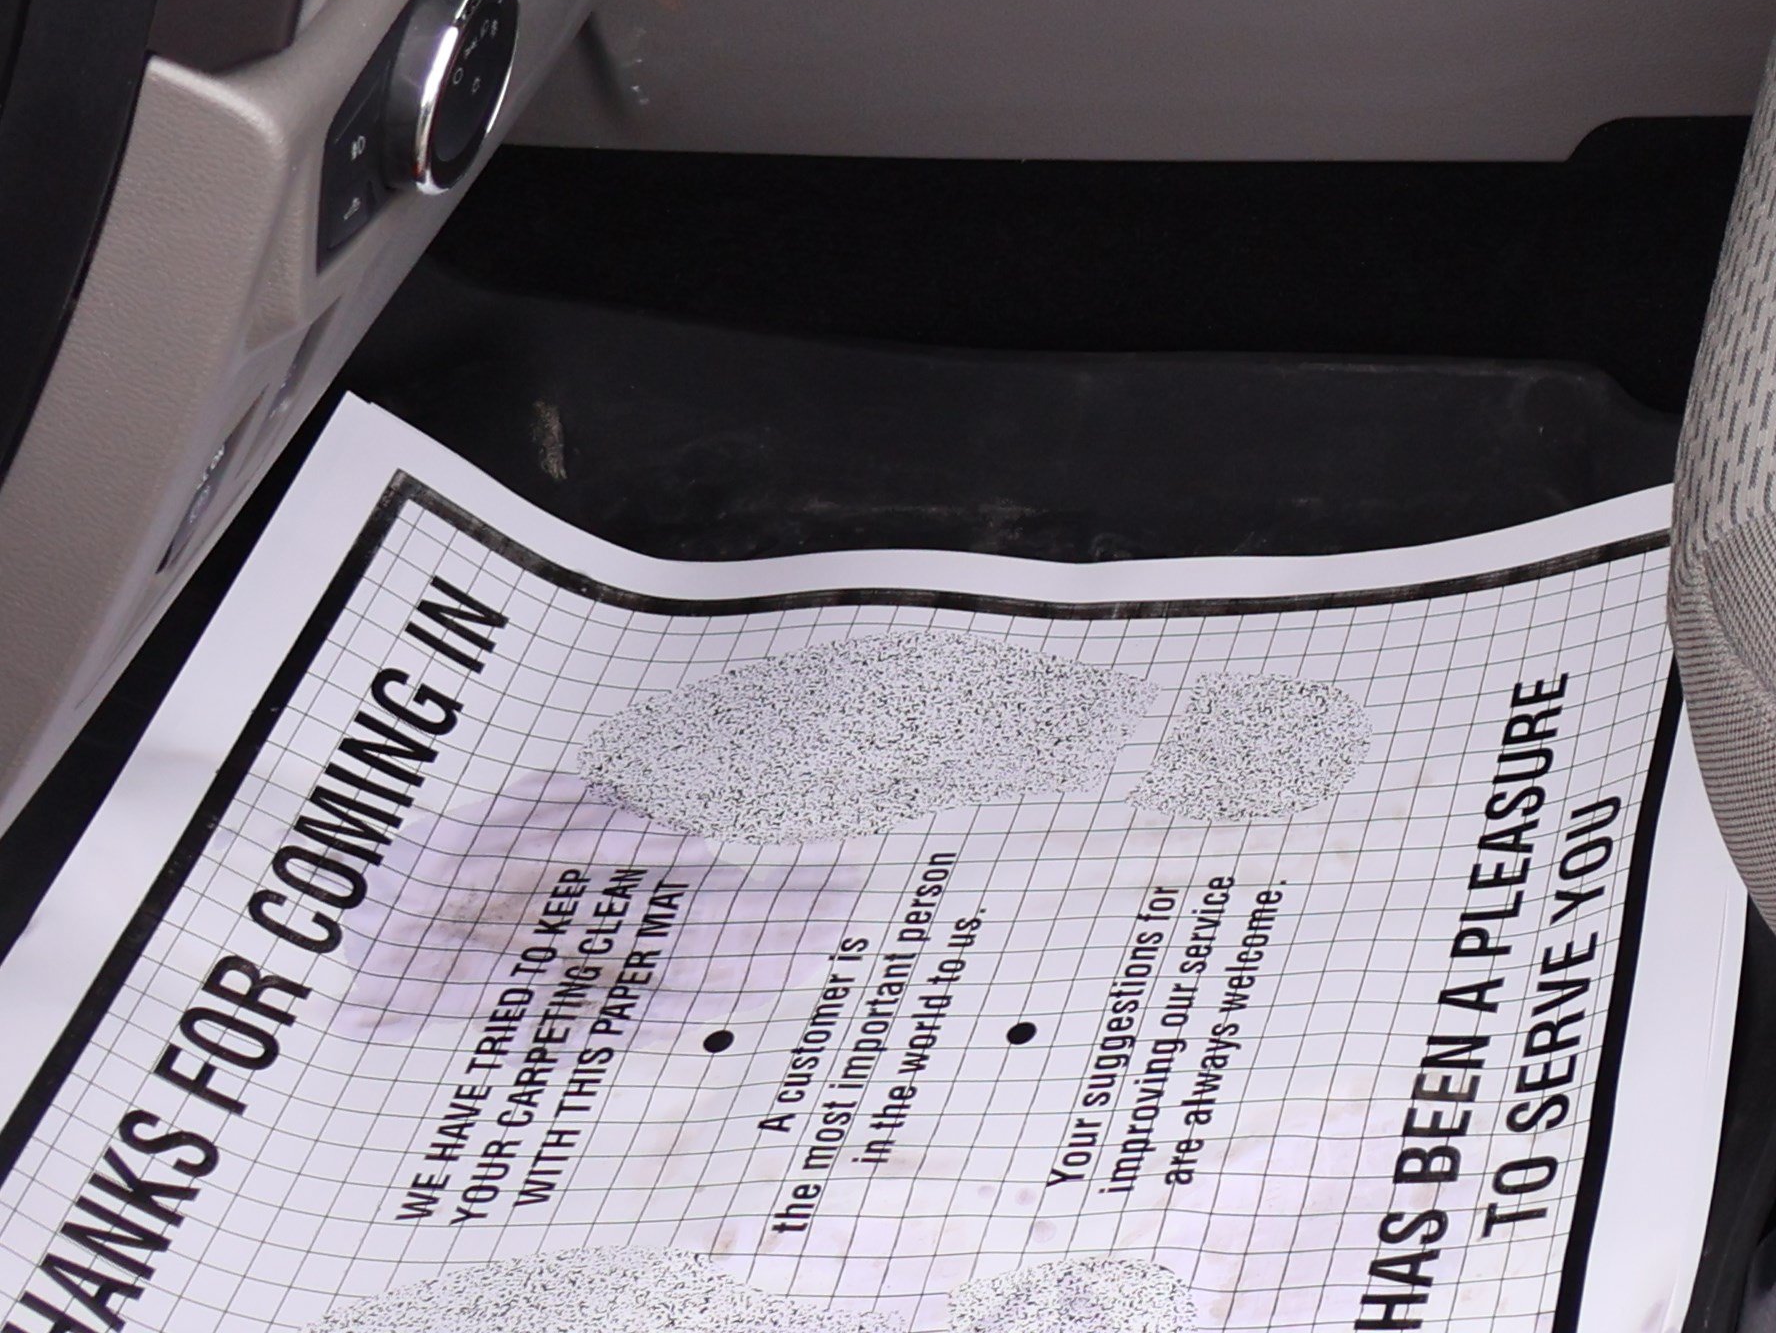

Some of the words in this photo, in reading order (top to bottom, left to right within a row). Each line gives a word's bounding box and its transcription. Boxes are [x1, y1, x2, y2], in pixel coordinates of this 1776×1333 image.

[153, 955, 313, 1116] FOR
[247, 667, 464, 954] COMING
[404, 575, 509, 674] IN
[1450, 671, 1570, 959] PLEASURE
[534, 868, 591, 935] KEEP
[897, 852, 957, 943] person
[1549, 794, 1622, 926] YOU
[511, 946, 558, 978] TO
[828, 936, 869, 962] is
[947, 907, 987, 949] us.
[1179, 876, 1234, 974] service
[1219, 880, 1287, 1014] welcome.
[927, 958, 965, 985] to
[1161, 983, 1198, 1027] our
[1439, 976, 1505, 1014] A
[450, 1139, 522, 1225] YOUR
[497, 966, 603, 1127] CARPETING
[579, 868, 649, 955] CLEAN
[466, 987, 535, 1076] TRIED
[513, 1129, 582, 1207] WITH
[554, 1046, 615, 1118] THIS
[589, 949, 662, 1035] PAPER
[636, 879, 690, 938] MAT
[776, 972, 856, 1104] customer
[828, 951, 917, 1090] important
[898, 994, 953, 1075] world
[1046, 1118, 1102, 1188] Your
[1082, 931, 1163, 1107] suggestions
[1137, 886, 1179, 922] for
[1506, 930, 1599, 1132] SERVE
[869, 1084, 917, 1130] the
[1098, 1037, 1187, 1194] improving
[1181, 1022, 1241, 1125] always
[1393, 1034, 1491, 1185] BEEN
[425, 1084, 493, 1161] HAVE
[757, 1112, 796, 1133] A
[802, 1099, 857, 1171] most
[851, 1138, 896, 1164] in
[1165, 1137, 1204, 1185] are
[395, 1173, 452, 1221] WE
[771, 1182, 822, 1233] the
[1482, 1154, 1559, 1239] TO
[1354, 1208, 1449, 1331] HAS
